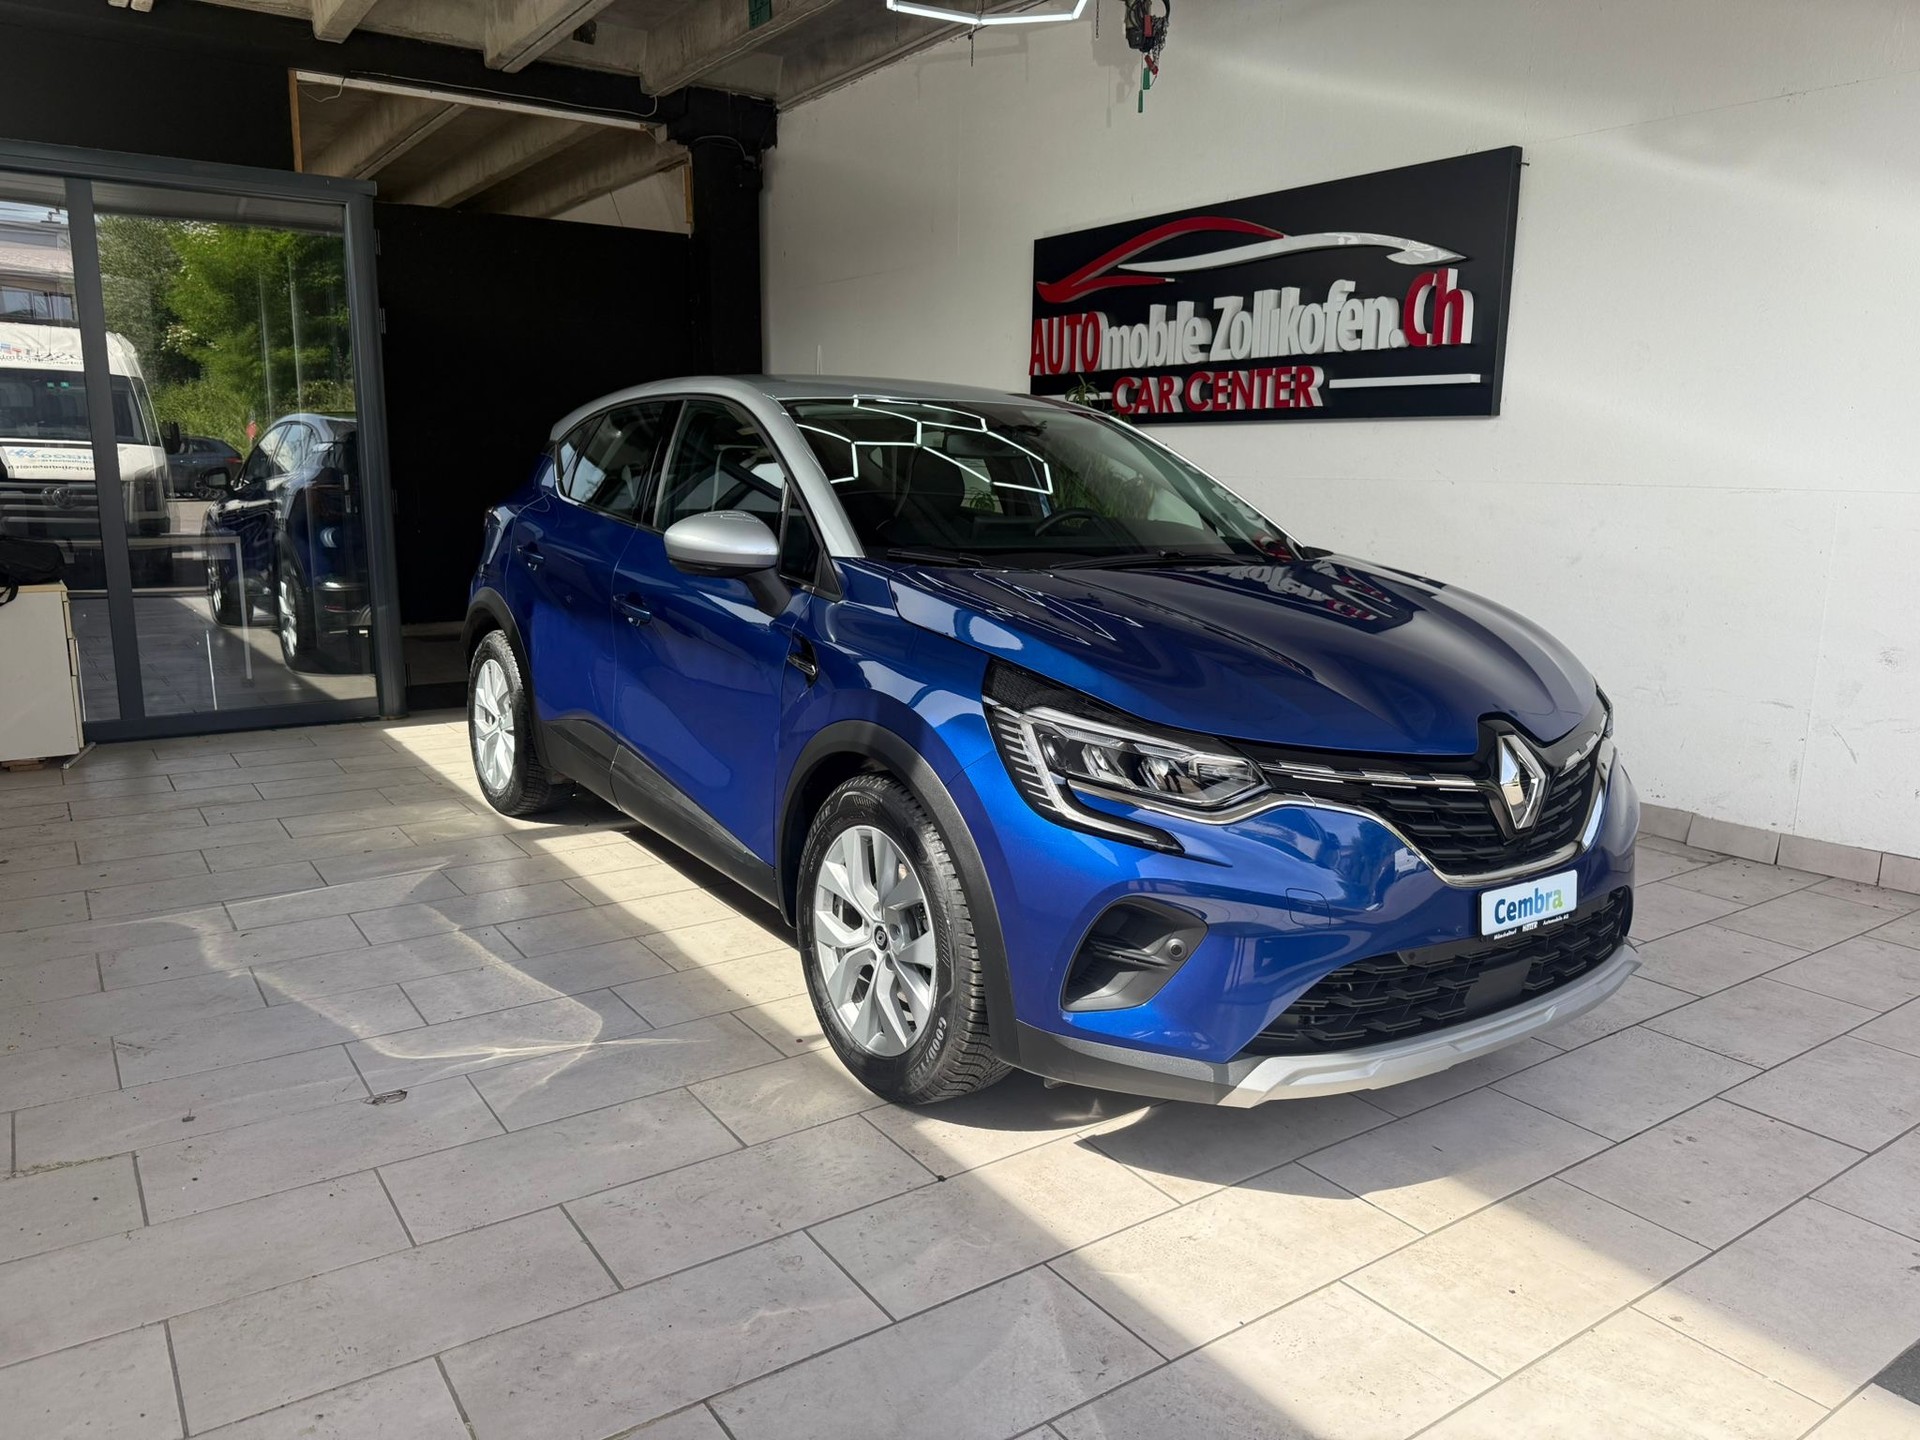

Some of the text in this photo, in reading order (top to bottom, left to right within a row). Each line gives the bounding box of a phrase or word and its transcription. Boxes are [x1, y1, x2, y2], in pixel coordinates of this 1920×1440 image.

[1029, 268, 1474, 376] AUTOmobile Zollikofen.Ch
[1112, 366, 1324, 414] CAR CENTER
[1494, 887, 1563, 925] Cembra
